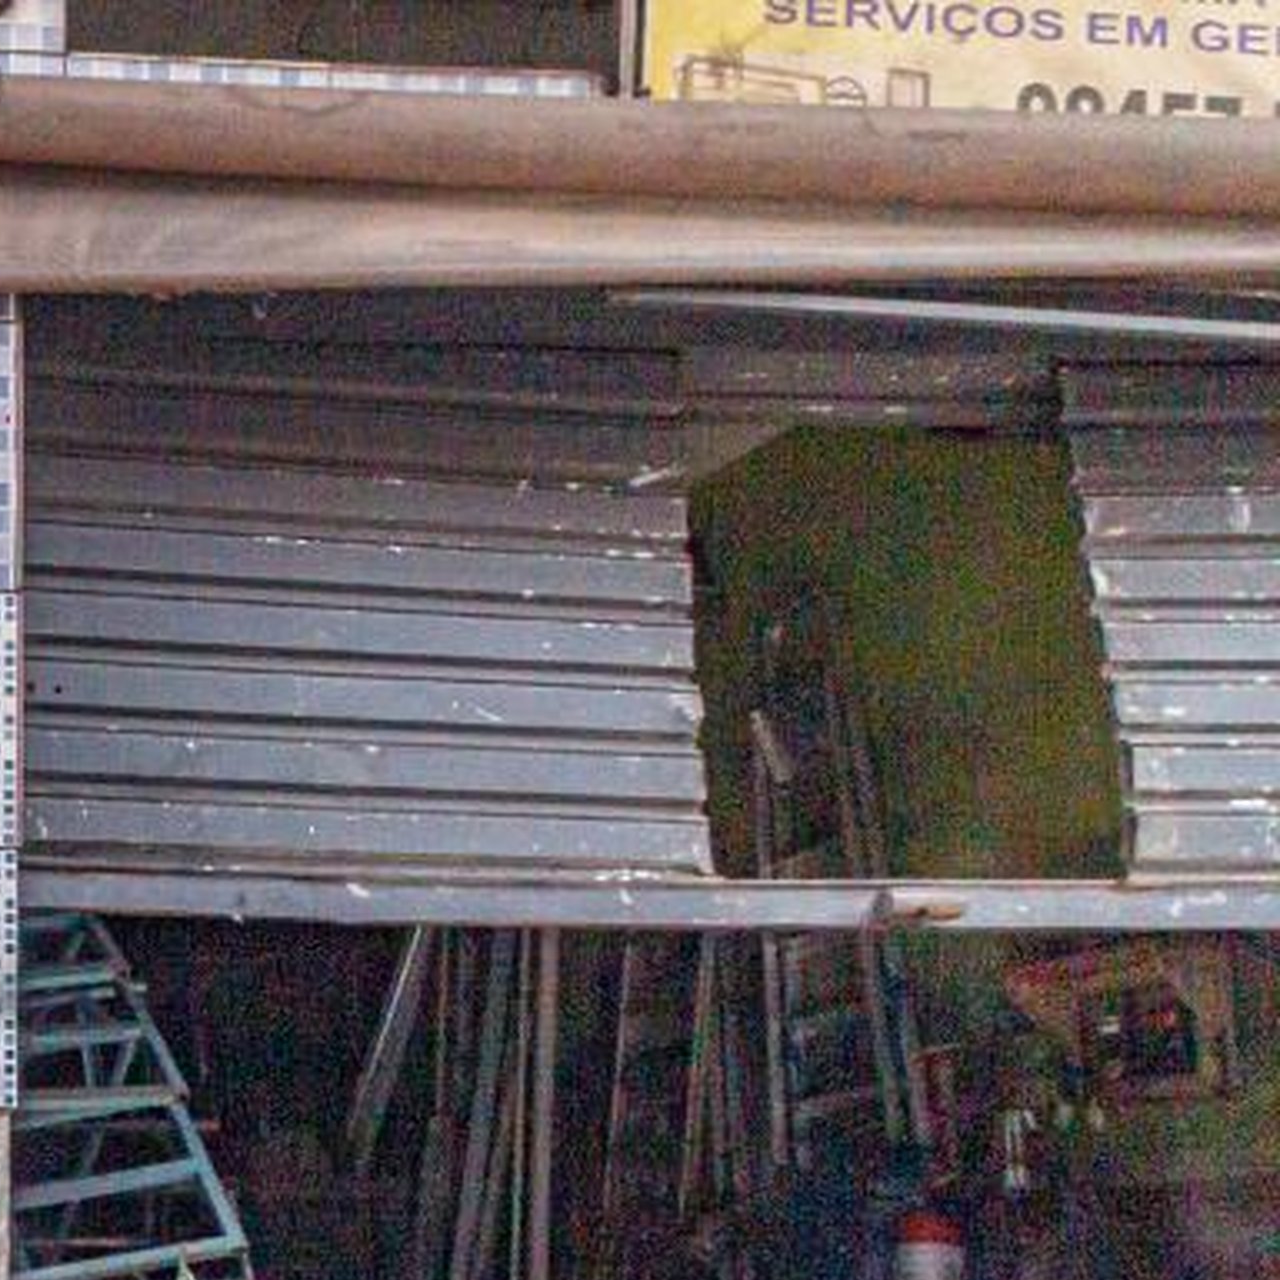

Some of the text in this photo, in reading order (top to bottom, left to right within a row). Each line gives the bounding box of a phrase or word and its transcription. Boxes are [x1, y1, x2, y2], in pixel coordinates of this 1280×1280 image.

[764, 0, 1280, 56] SERVIÇOS EM GE
